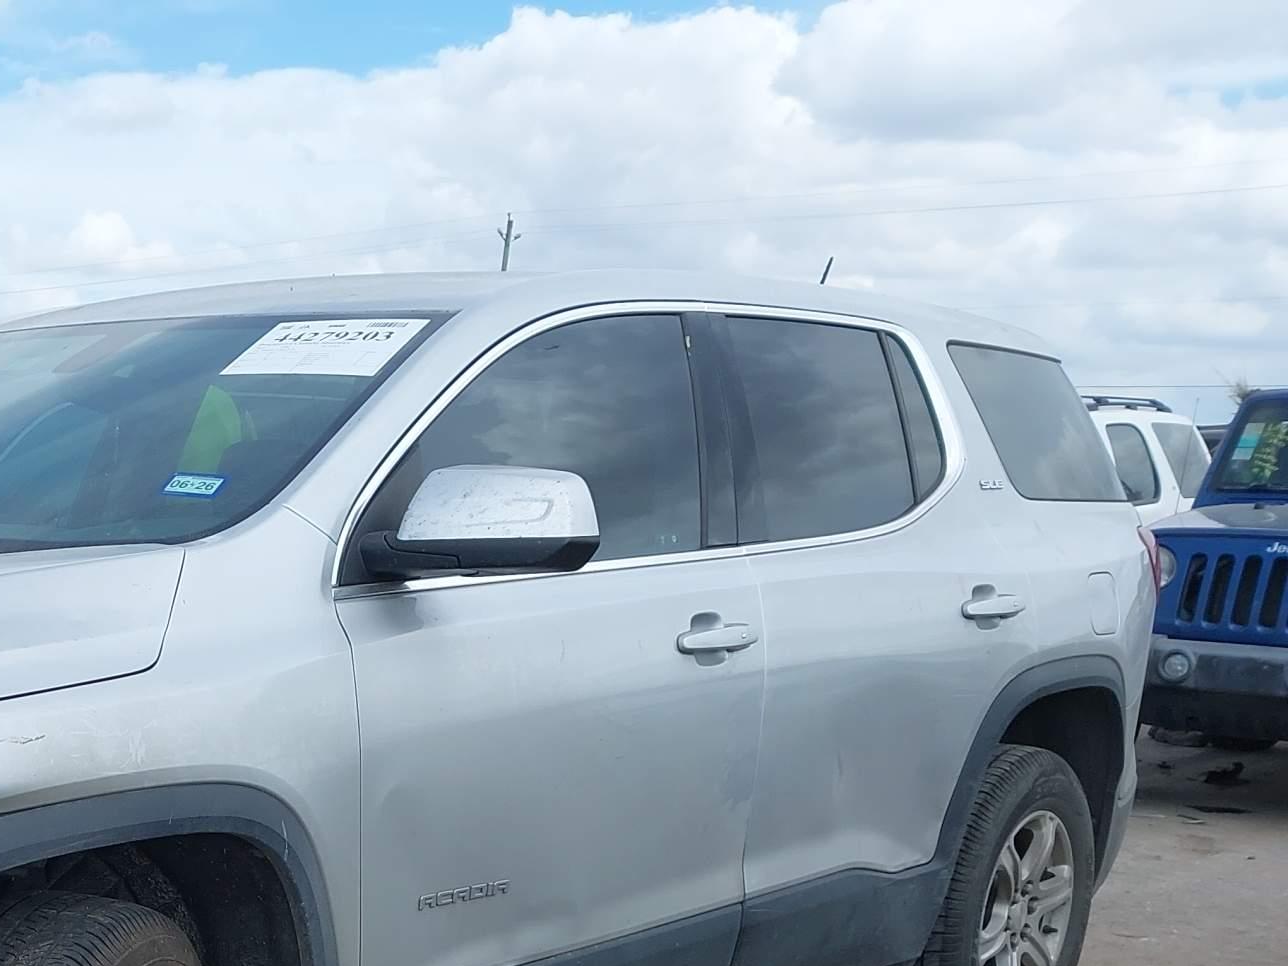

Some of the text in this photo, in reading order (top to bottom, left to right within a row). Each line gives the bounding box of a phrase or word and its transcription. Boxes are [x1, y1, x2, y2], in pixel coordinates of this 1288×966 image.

[274, 331, 395, 343] 44279203
[170, 479, 216, 491] 06 26
[978, 480, 1004, 490] SLE
[1266, 541, 1288, 553] Je
[418, 879, 511, 911] ACADIA
